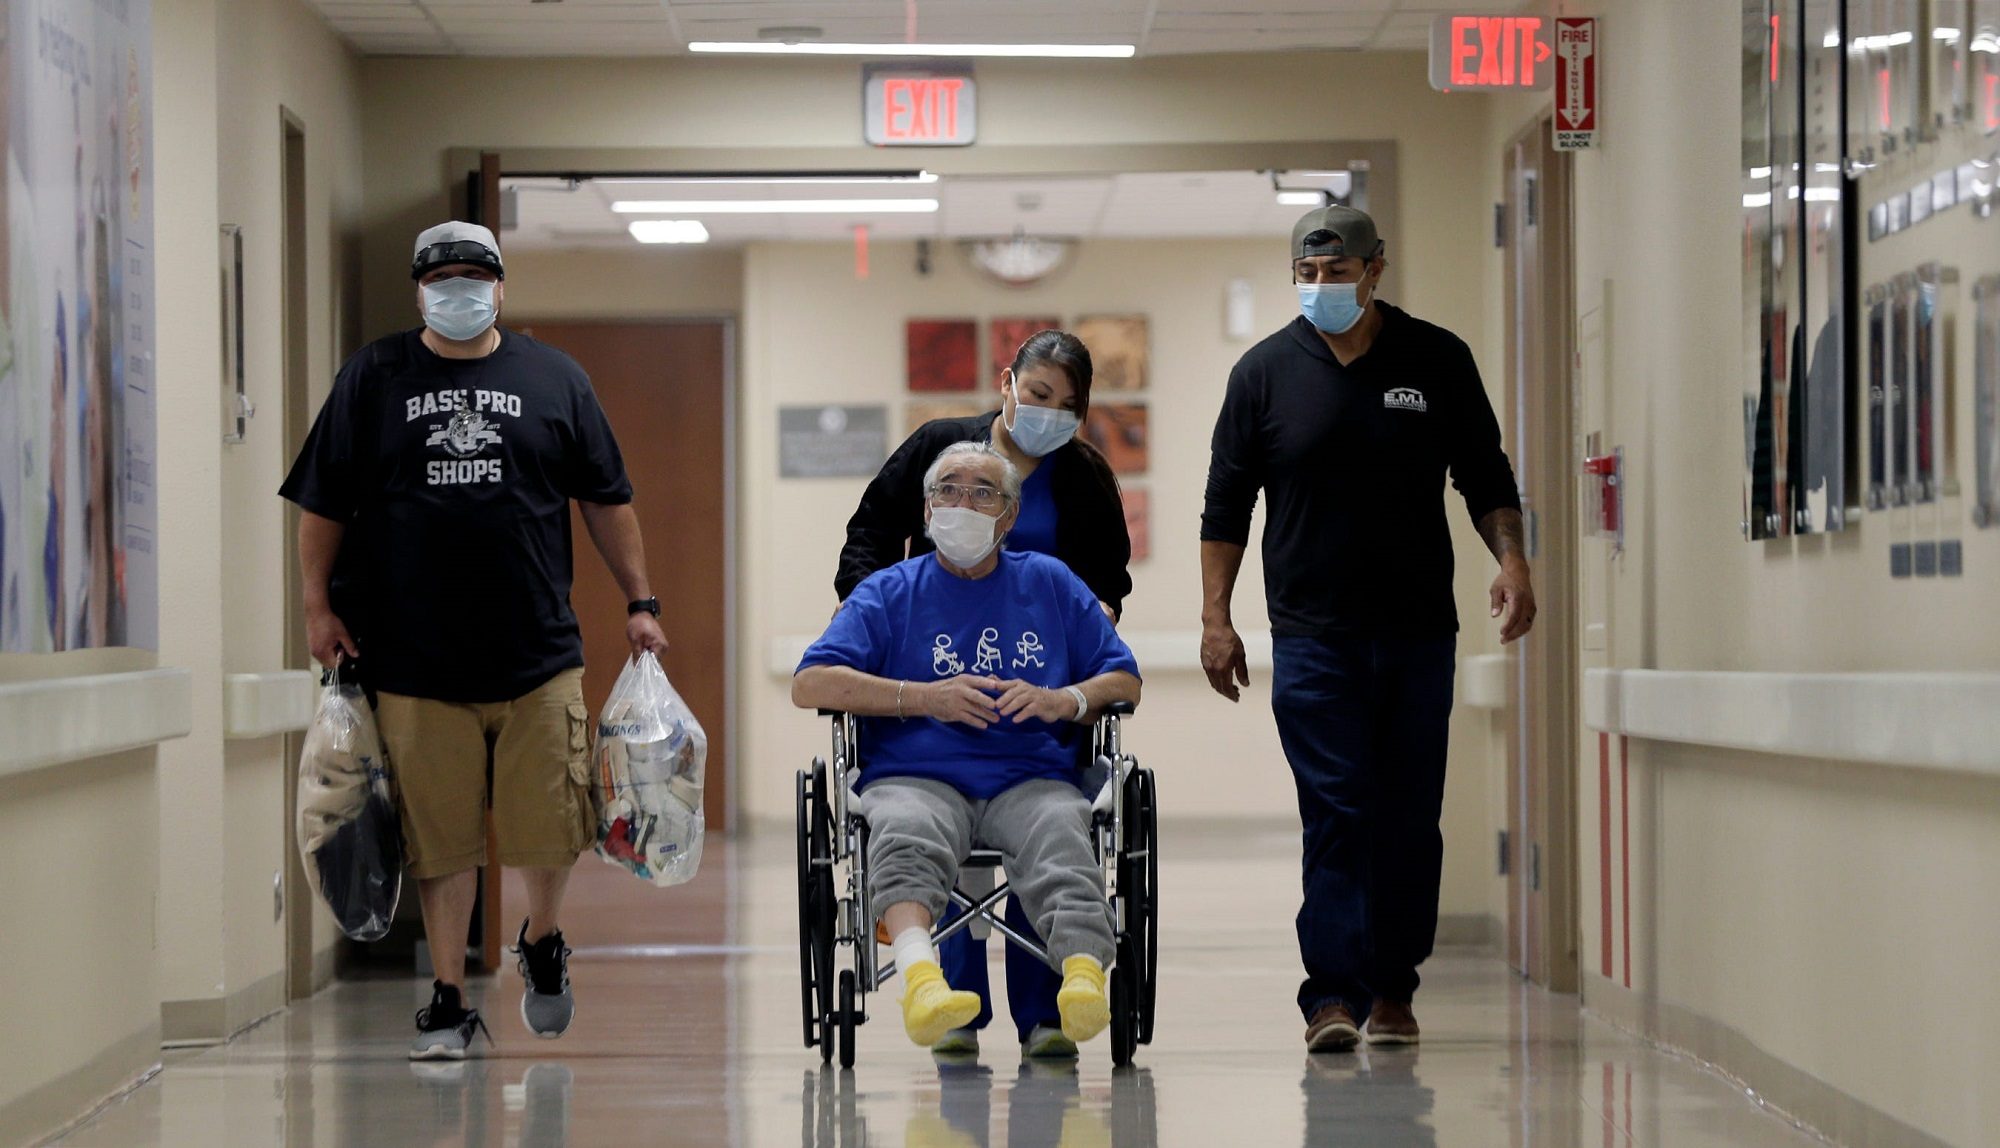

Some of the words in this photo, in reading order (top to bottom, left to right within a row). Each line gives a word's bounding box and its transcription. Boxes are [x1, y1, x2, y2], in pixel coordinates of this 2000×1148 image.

[1451, 16, 1542, 86] EXIT
[1561, 30, 1589, 43] FIRE
[1571, 44, 1579, 124] EXTINGUISHER
[884, 79, 964, 138] EXIT
[406, 389, 467, 422] BASS
[475, 389, 521, 418] PRO
[427, 459, 502, 485] SHOPS
